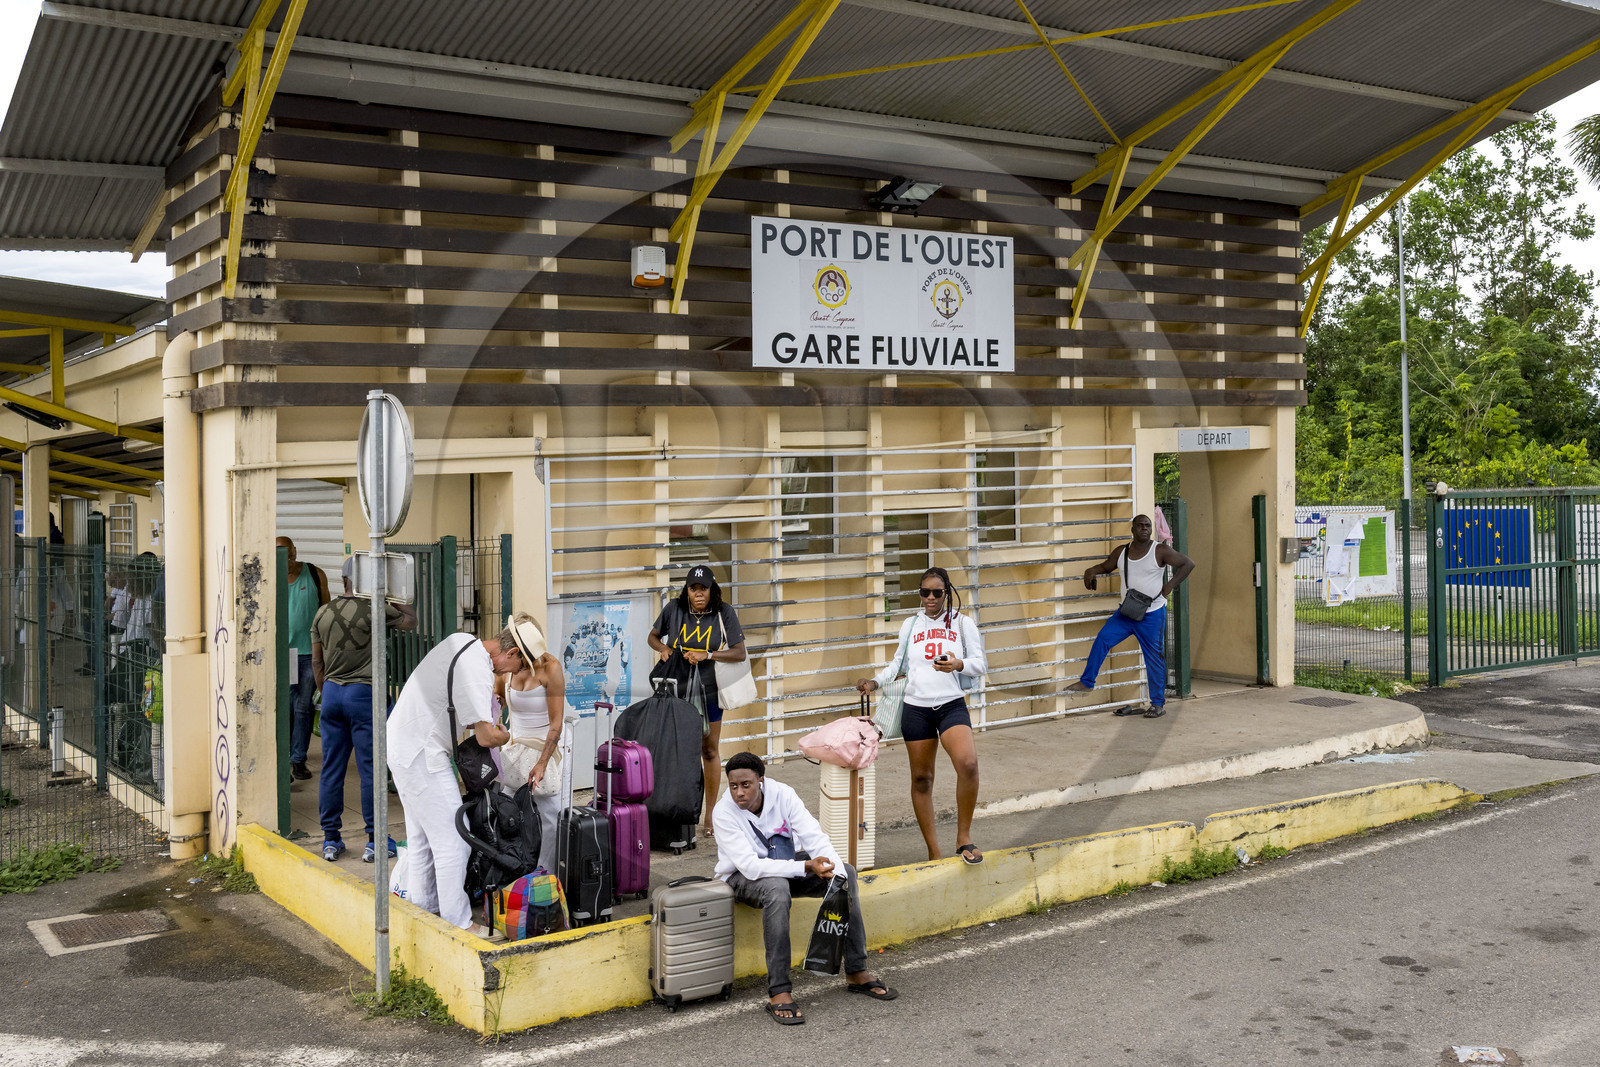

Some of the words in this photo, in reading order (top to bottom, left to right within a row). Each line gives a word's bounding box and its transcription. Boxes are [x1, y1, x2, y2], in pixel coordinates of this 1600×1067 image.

[762, 223, 841, 258] PORT
[853, 230, 889, 262] DE
[901, 233, 1008, 269] L'OUEST
[921, 271, 937, 293] PORT
[937, 268, 948, 276] DE
[949, 268, 973, 296] L'OUEST
[820, 287, 845, 302] CCOG
[772, 332, 860, 364] GARE
[872, 335, 999, 367] FLUVIALE
[1197, 432, 1232, 445] DEPART
[694, 568, 704, 577] NY
[913, 631, 925, 644] LOS
[925, 642, 942, 660] 91
